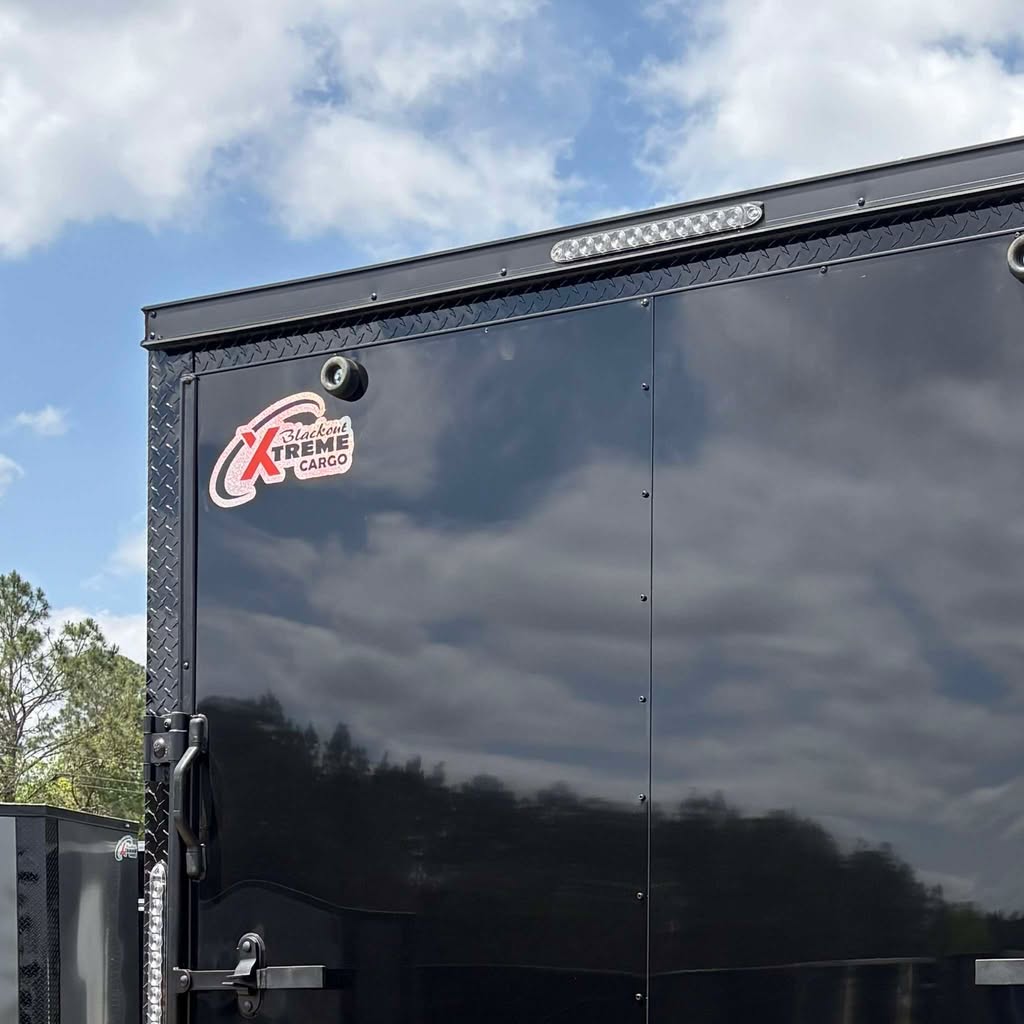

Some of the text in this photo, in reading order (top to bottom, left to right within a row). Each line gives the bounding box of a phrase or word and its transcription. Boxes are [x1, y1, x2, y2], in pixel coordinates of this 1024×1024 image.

[280, 422, 347, 444] Blackout
[240, 426, 349, 481] XTREME
[300, 453, 348, 472] CARGO
